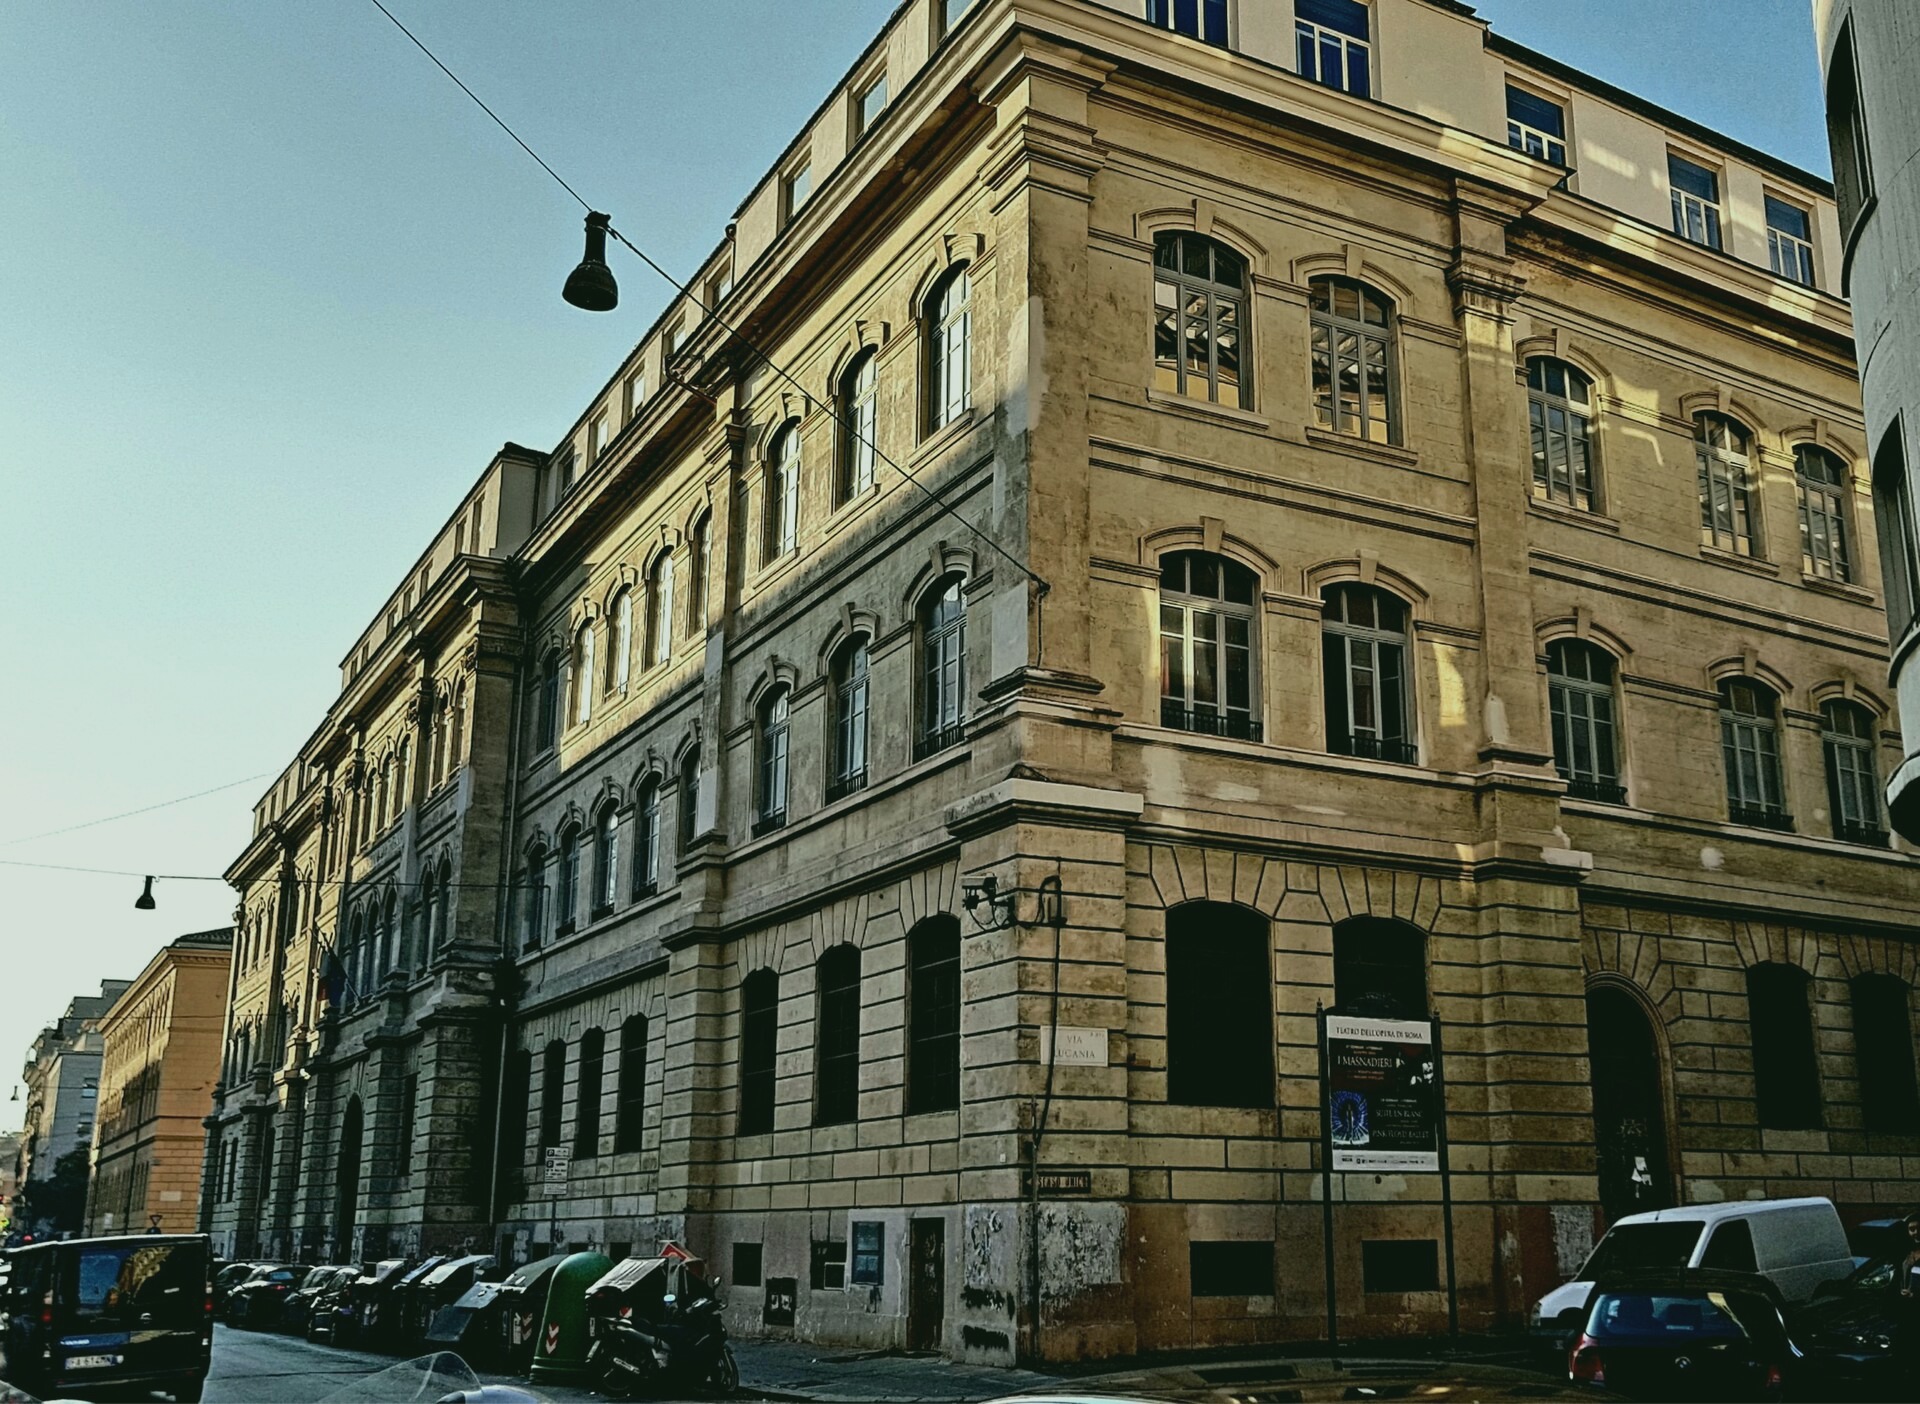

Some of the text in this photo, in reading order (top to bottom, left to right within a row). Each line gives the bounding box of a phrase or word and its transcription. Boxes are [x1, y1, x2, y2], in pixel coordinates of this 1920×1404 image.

[1336, 1027, 1359, 1035] TEATRO
[1404, 1031, 1423, 1040] ROMA
[1067, 1035, 1082, 1044] VIA
[1055, 1048, 1095, 1059] UCANIA
[1342, 1056, 1392, 1068] MASNADIERI
